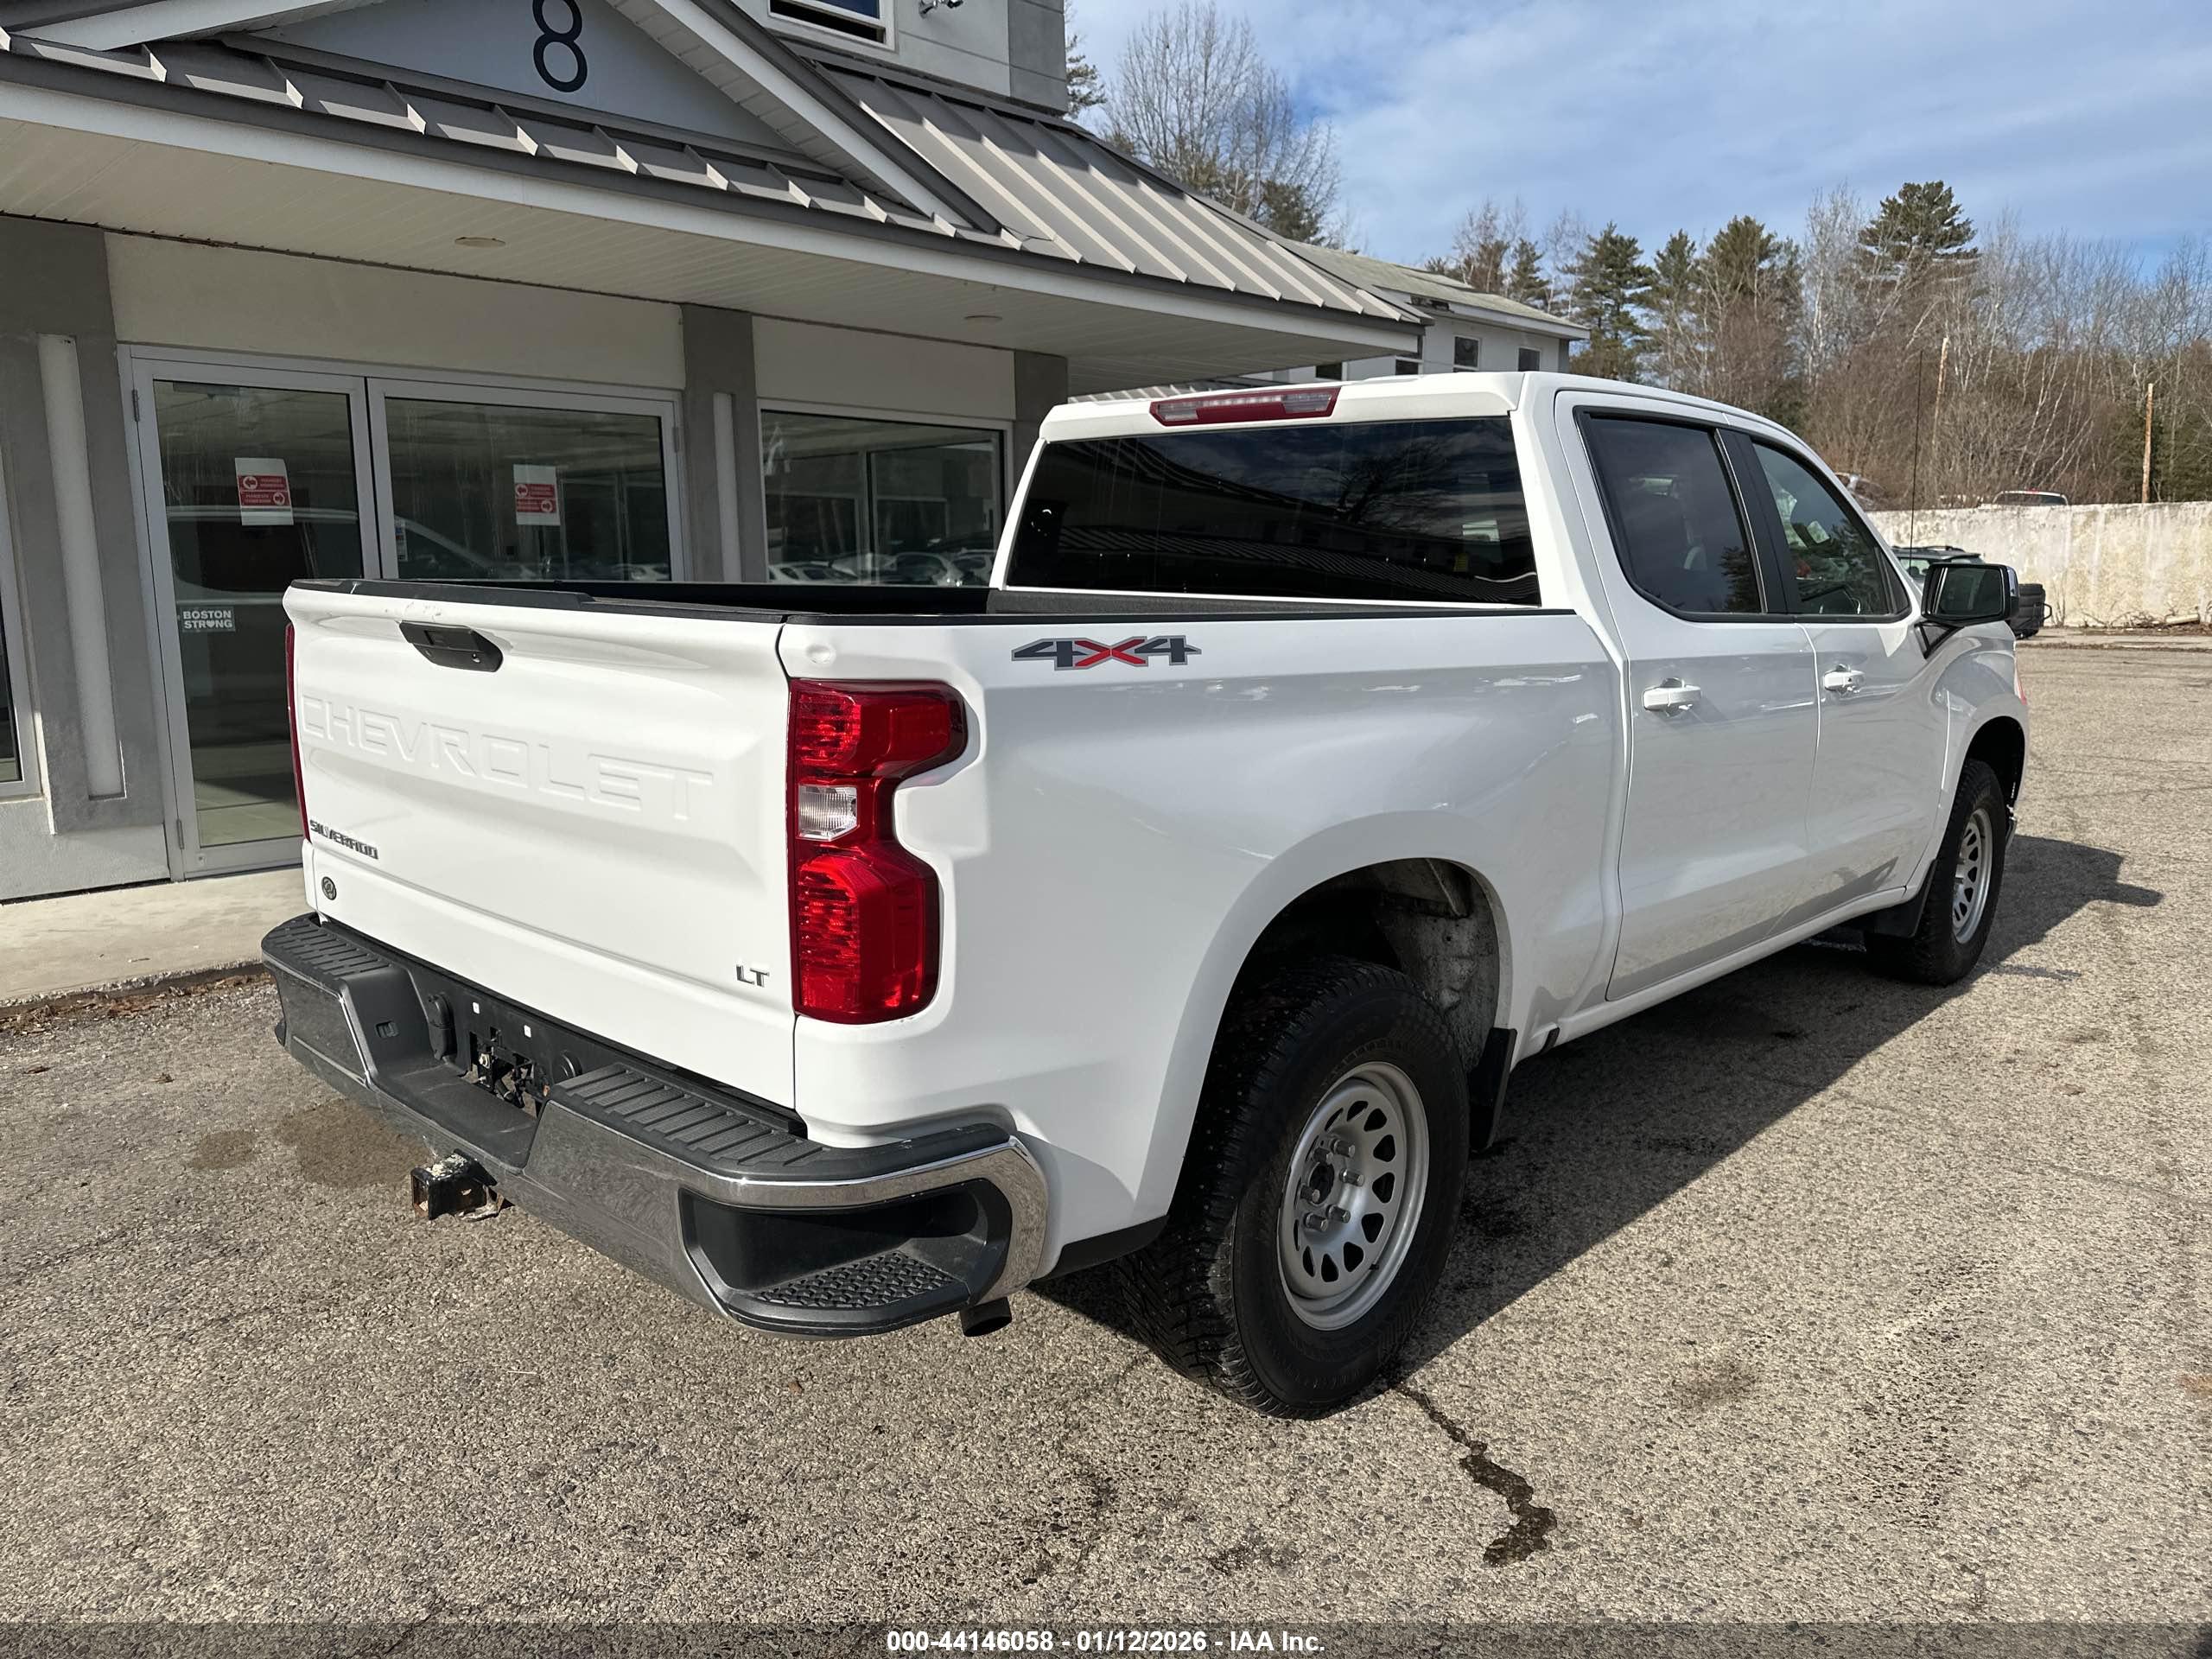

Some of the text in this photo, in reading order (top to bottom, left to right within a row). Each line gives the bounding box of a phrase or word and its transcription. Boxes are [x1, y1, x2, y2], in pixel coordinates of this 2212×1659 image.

[532, 0, 588, 92] 8
[183, 610, 232, 620] BOSTON
[300, 694, 715, 822] CHEVROLET
[309, 819, 379, 860] SILVERADO
[736, 964, 770, 988] LT
